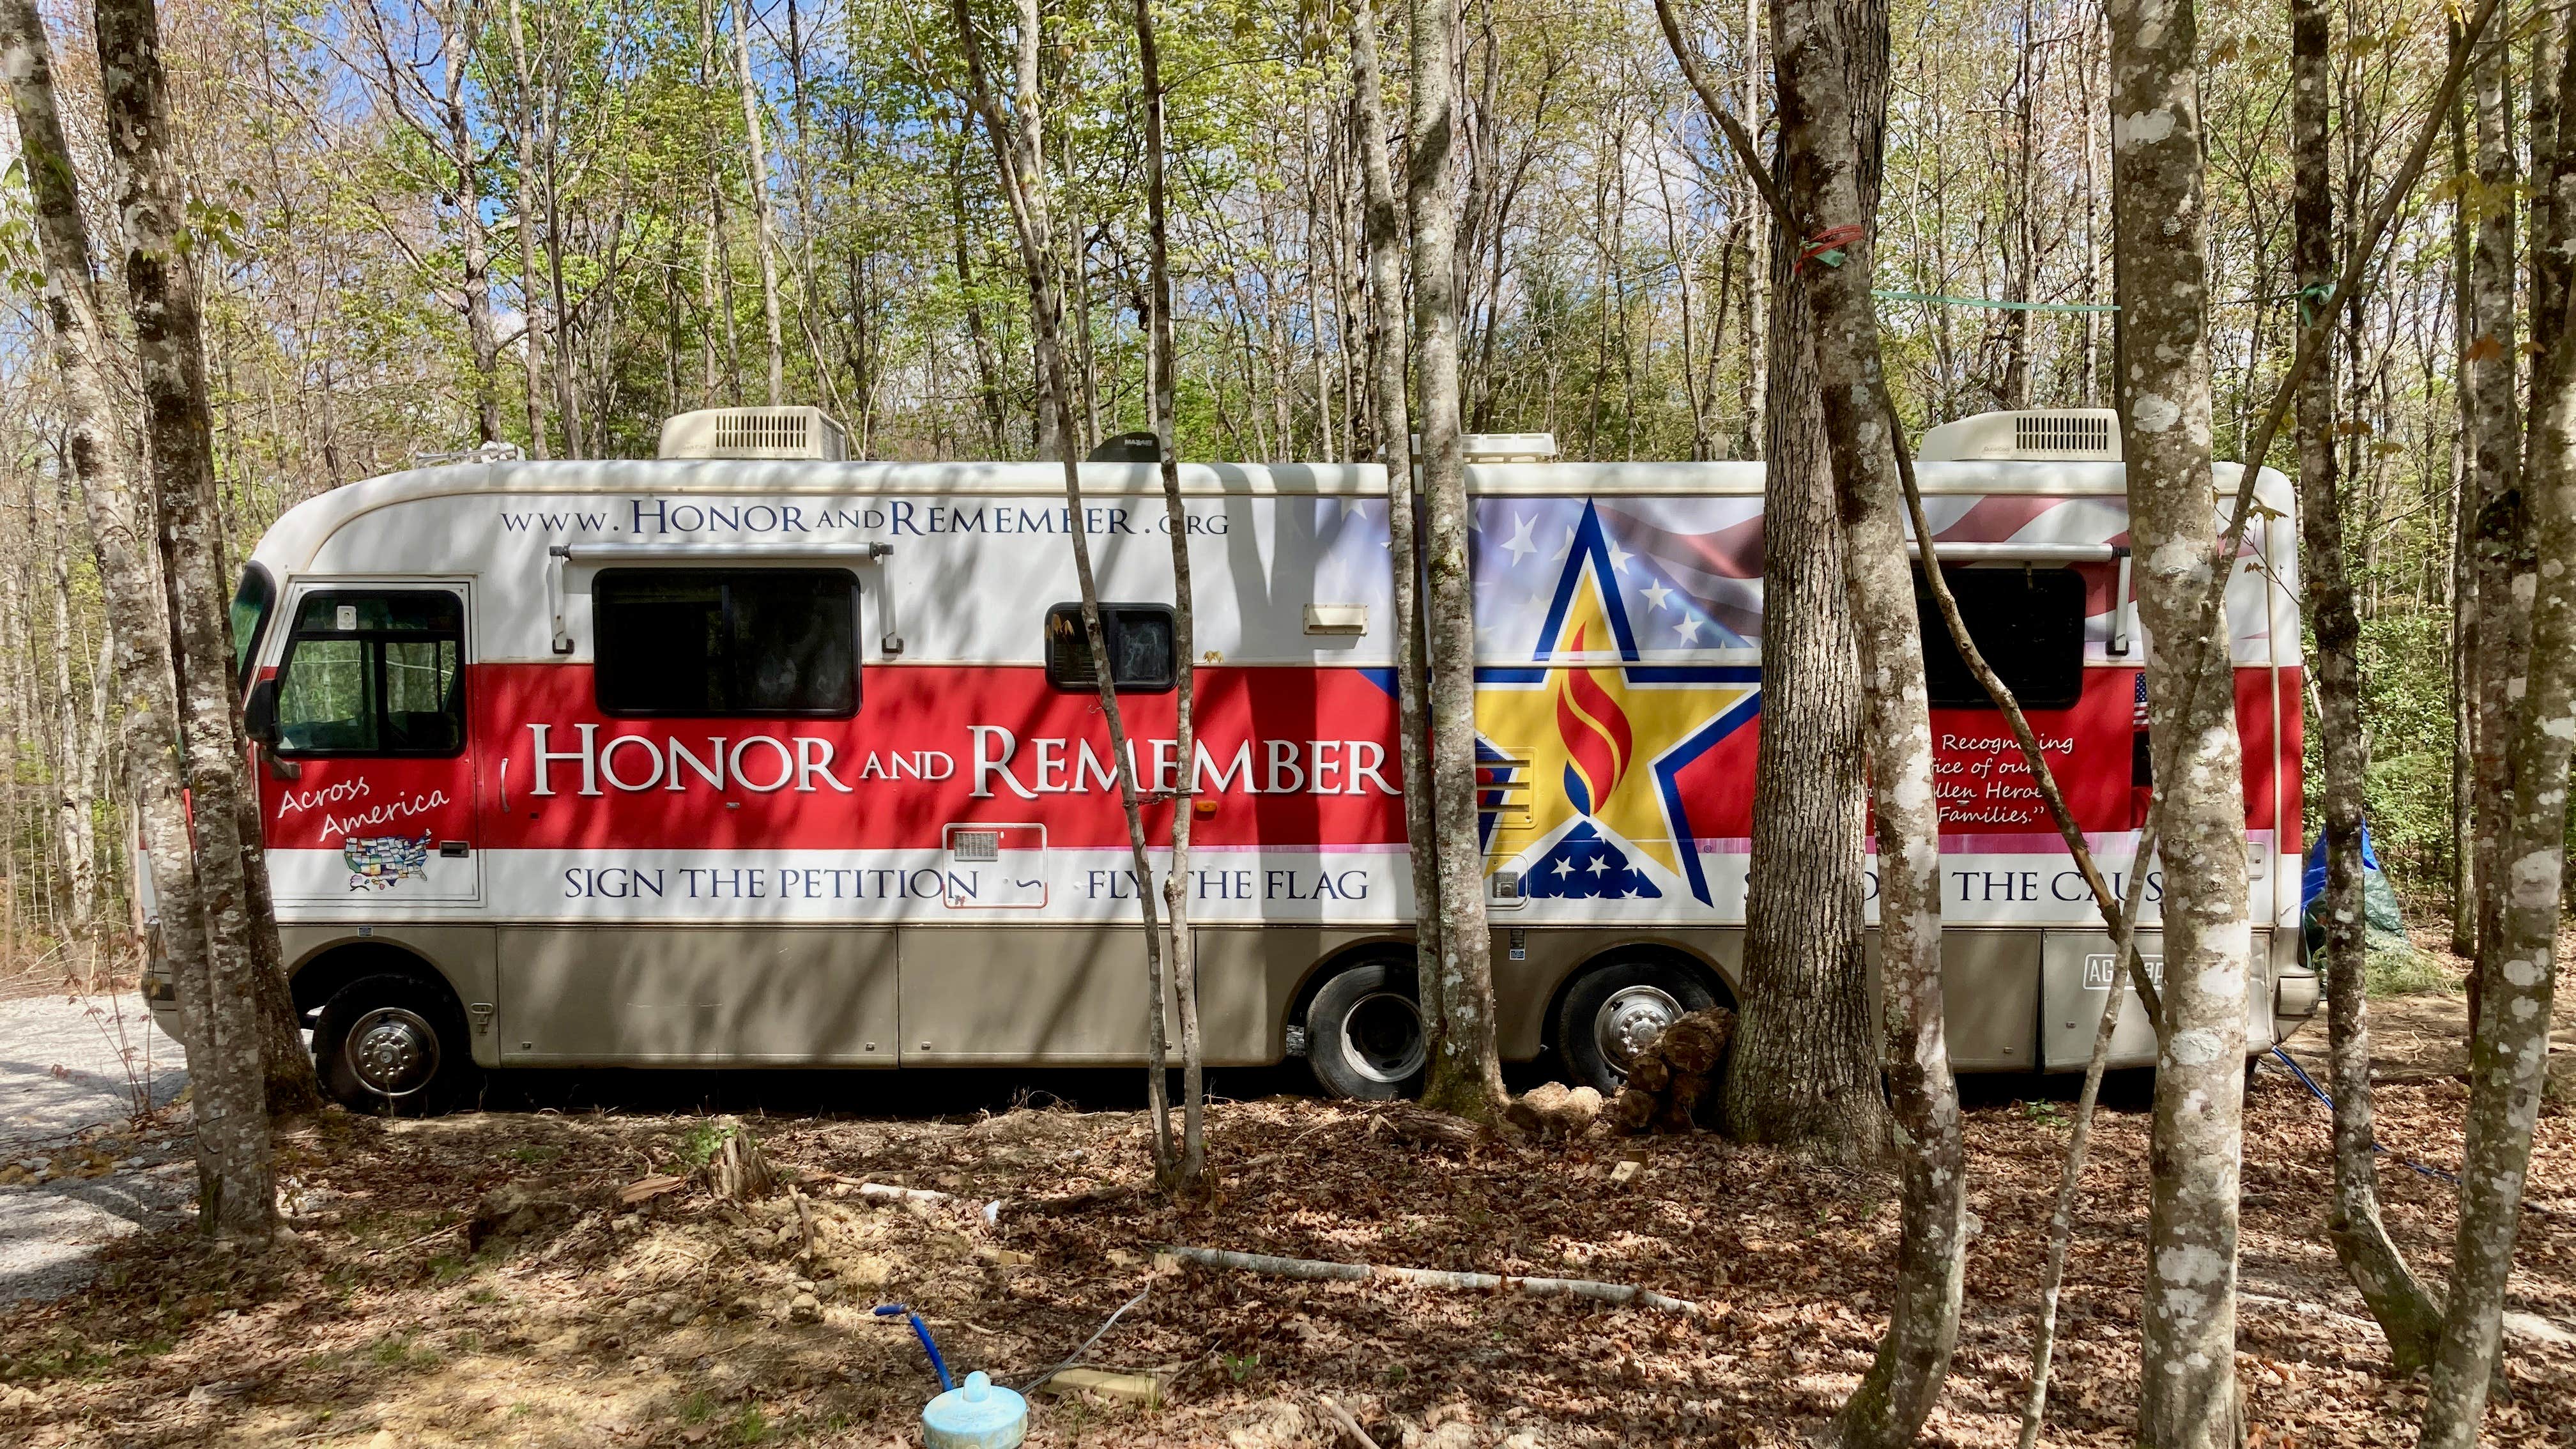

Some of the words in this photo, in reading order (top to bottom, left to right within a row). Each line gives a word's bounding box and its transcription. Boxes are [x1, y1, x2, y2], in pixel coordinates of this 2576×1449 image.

[1942, 733, 2073, 755] Recogning
[526, 723, 853, 796] HONOR
[859, 750, 954, 780] AND
[967, 724, 1402, 799] REMEMBER
[1970, 757, 1993, 779] of
[277, 776, 370, 818] Across
[1934, 781, 1977, 798] llen
[1985, 781, 2043, 799] Heroe
[319, 790, 450, 842] America
[565, 868, 665, 898] SIGN
[679, 868, 765, 898] THE
[779, 868, 979, 899] PETITION
[1265, 870, 1368, 900] FLAG
[1952, 871, 2038, 901] THE
[2051, 871, 2163, 901] CUS
